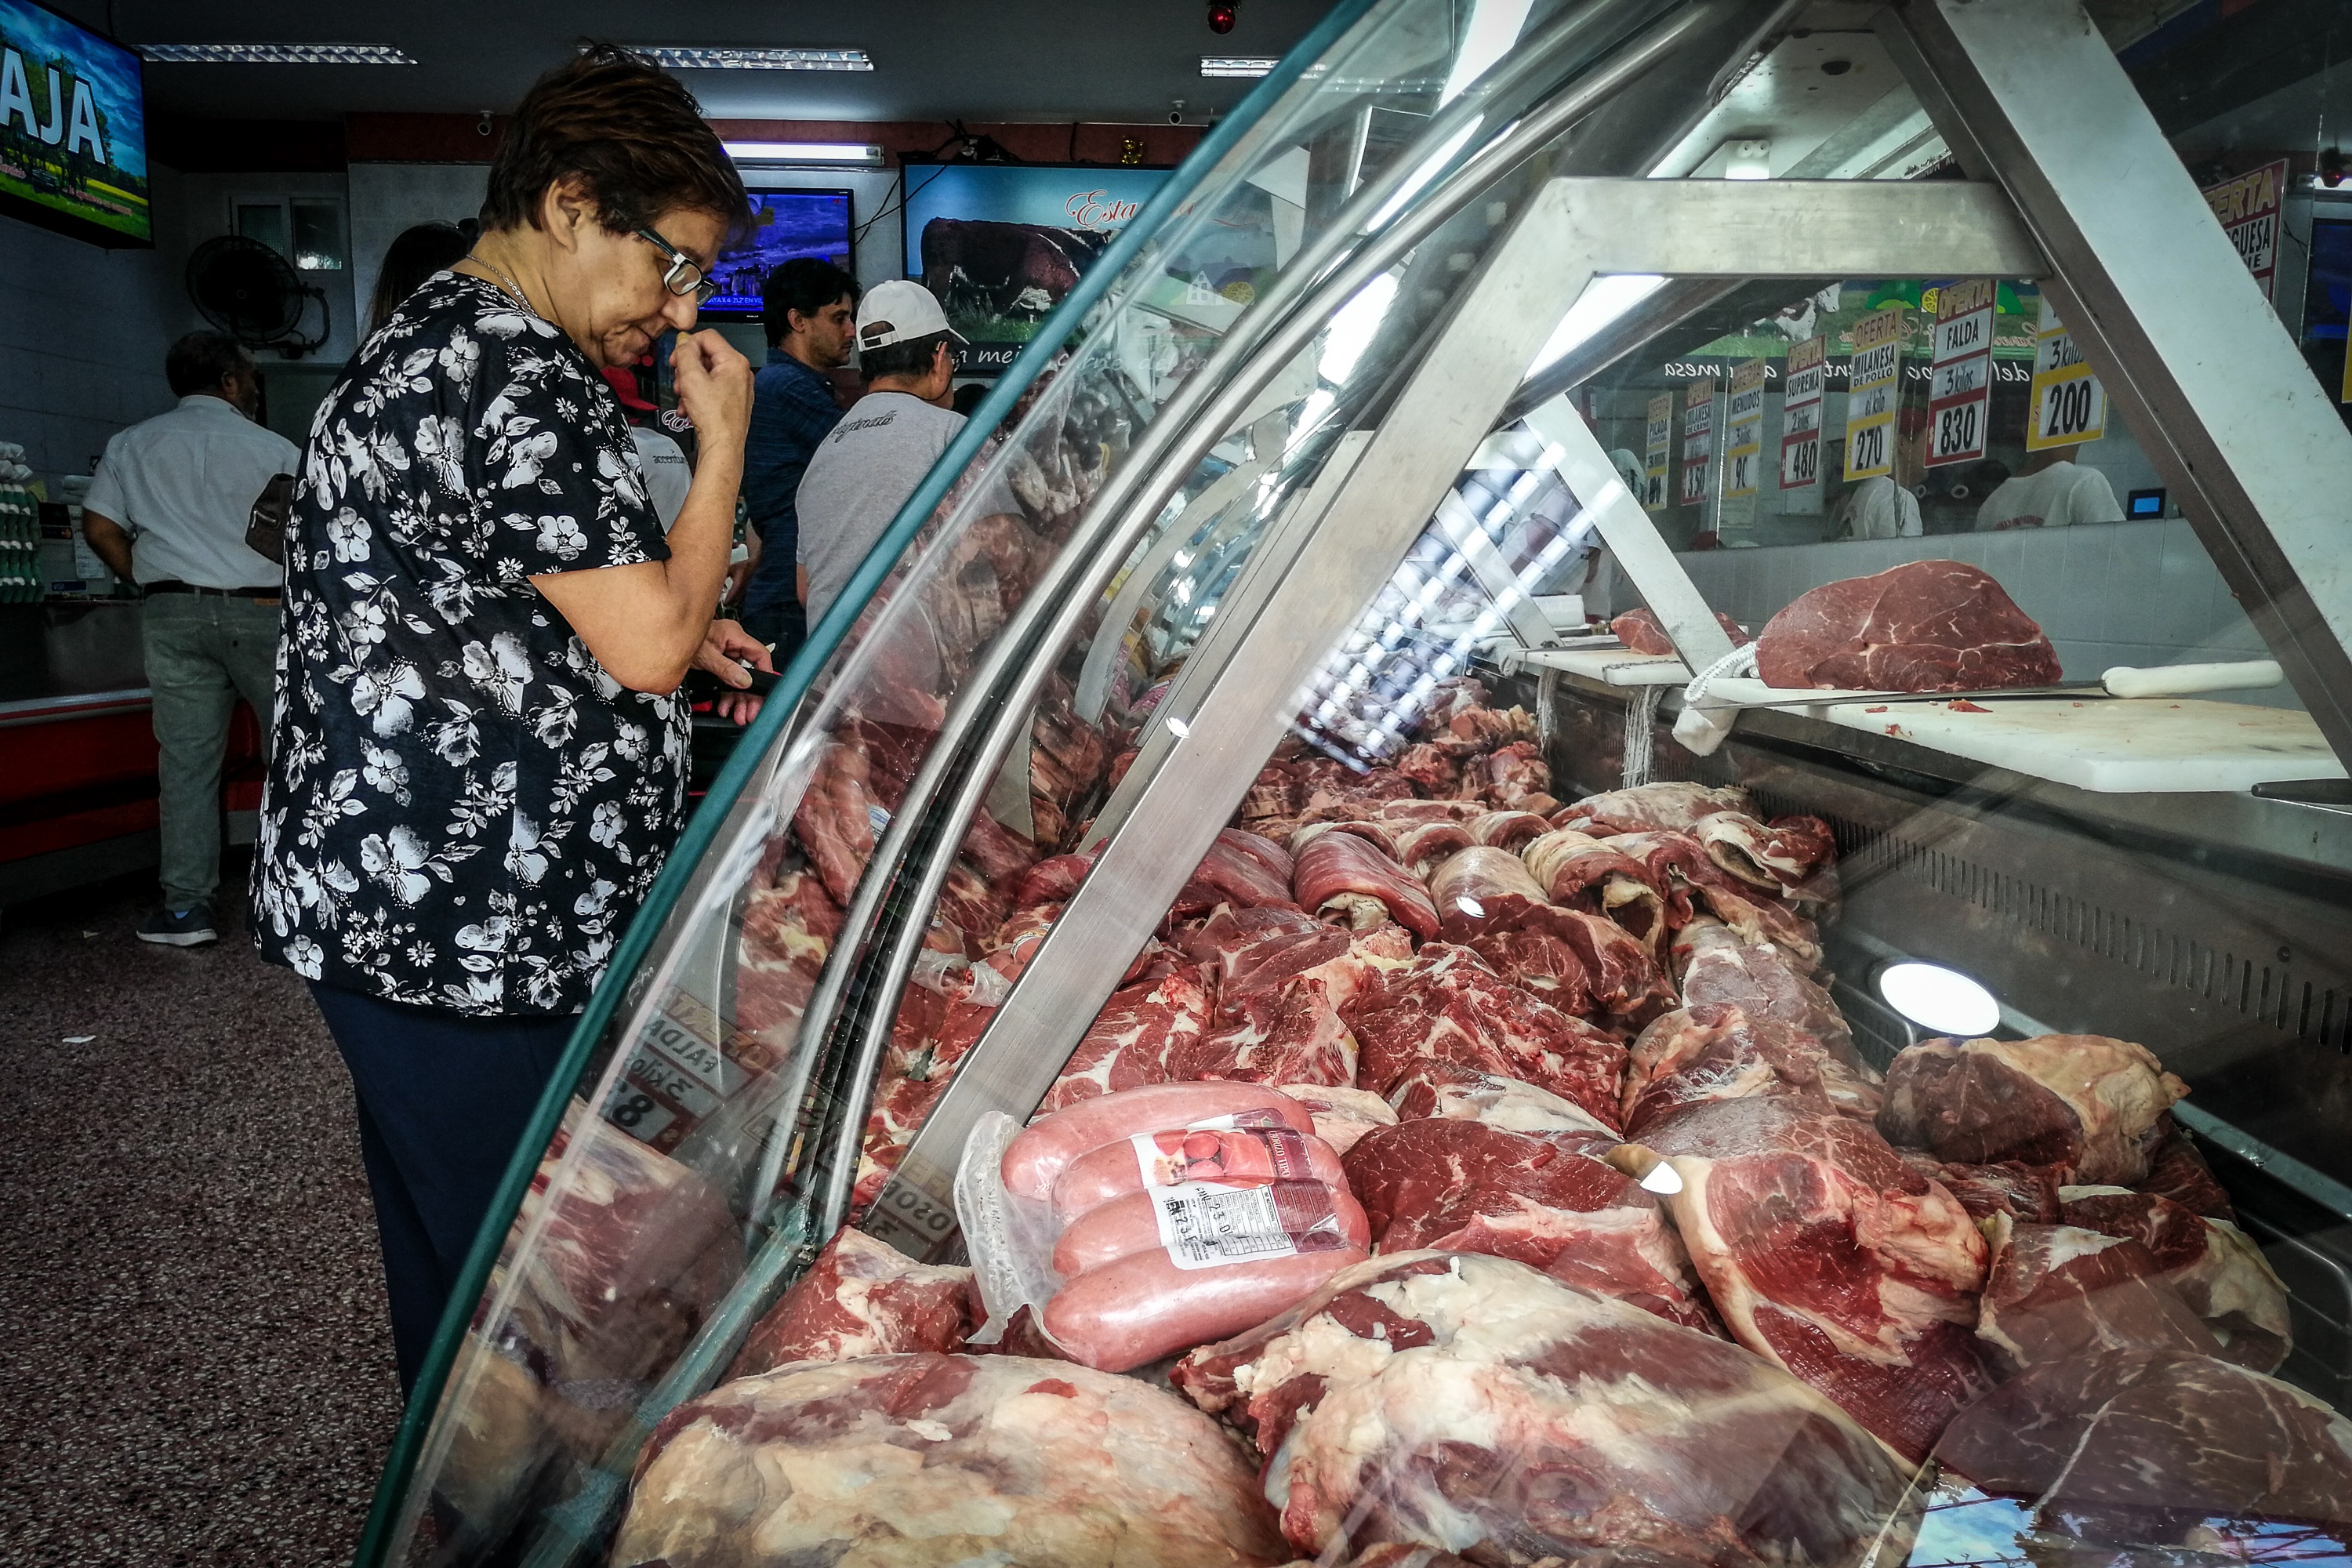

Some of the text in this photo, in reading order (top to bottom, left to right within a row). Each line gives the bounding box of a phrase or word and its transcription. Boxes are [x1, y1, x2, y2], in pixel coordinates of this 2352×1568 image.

[1938, 280, 1992, 320] OFERTA
[1856, 311, 1897, 347] OFERTA
[1947, 318, 1979, 350] FALDA
[1854, 344, 1895, 378] MILANESA
[2049, 340, 2060, 370] 3
[1788, 370, 1820, 398] SUPREMA
[1854, 376, 1864, 387] DE
[1865, 367, 1893, 384] POLLO
[1945, 369, 1953, 395] 3
[1732, 390, 1759, 415] MENUDOS
[2047, 380, 2091, 437] 200
[1940, 404, 1976, 456] 830
[1793, 441, 1817, 481] 480
[1856, 424, 1883, 471] 270
[1279, 1157, 1290, 1177] TIPO
